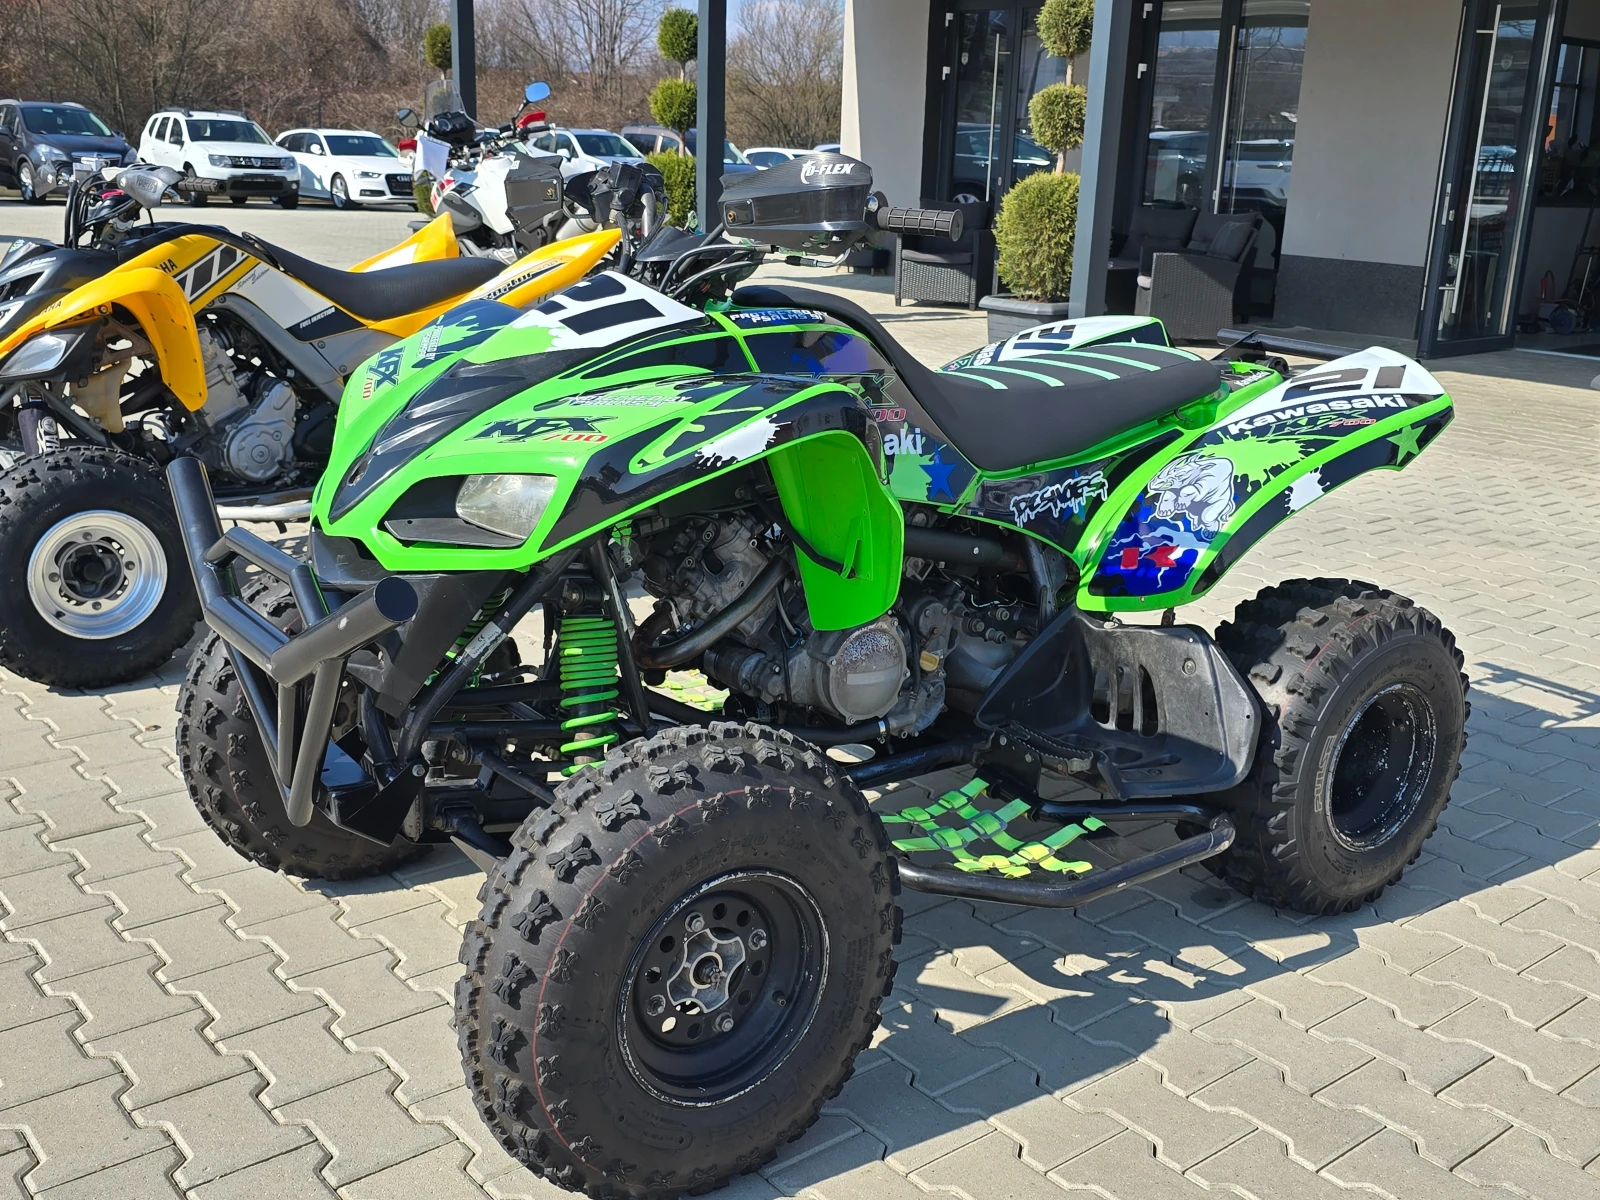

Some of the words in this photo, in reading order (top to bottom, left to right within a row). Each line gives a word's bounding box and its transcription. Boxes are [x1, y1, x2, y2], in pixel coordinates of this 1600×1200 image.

[300, 318, 312, 329] FUEL
[311, 306, 336, 323] INJECTION
[751, 313, 808, 323] PSALMS
[366, 345, 406, 392] KFX
[1227, 394, 1408, 435] Kawasaki
[464, 415, 619, 443] KFX
[542, 434, 608, 443] 700
[883, 428, 923, 455] aki
